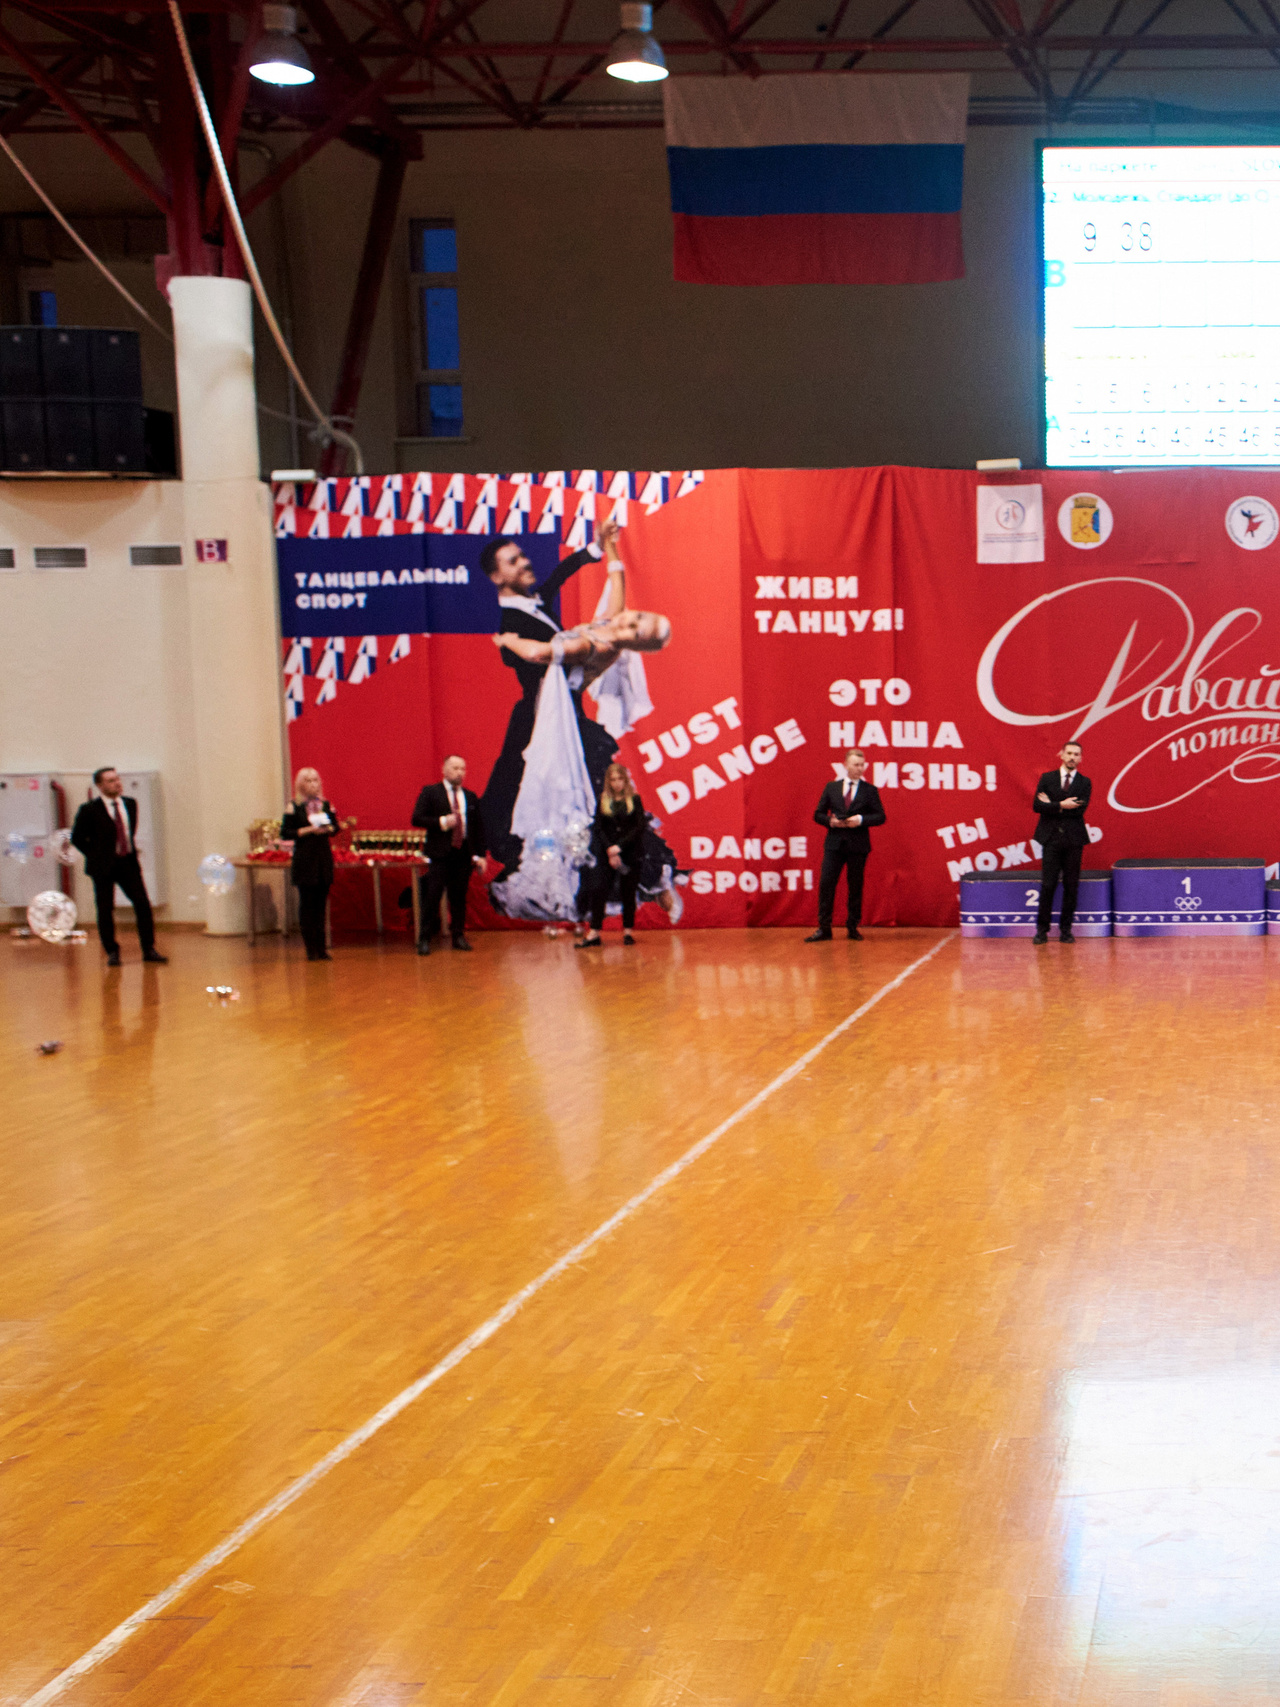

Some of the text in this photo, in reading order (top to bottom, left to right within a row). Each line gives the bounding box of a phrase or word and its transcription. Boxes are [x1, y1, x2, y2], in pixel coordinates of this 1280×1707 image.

[1083, 222, 1153, 252] 9 38
[294, 565, 470, 590] ТАНЦЕВАЛЬНЫЙ
[755, 575, 859, 601] ЖИВИ
[295, 592, 367, 610] СПОРТ
[755, 608, 904, 637] ТАНЦУЯ!
[829, 677, 912, 707] ЭТО
[637, 696, 742, 774] JUST
[829, 720, 965, 749] НАША
[656, 718, 807, 815] DANCE
[690, 835, 808, 860] DANCE
[936, 817, 990, 849] ТЫ
[946, 822, 1104, 883] МОЖЬ
[691, 869, 814, 894] SPORT!
[1181, 876, 1192, 895] 1
[1025, 889, 1040, 907] 2
